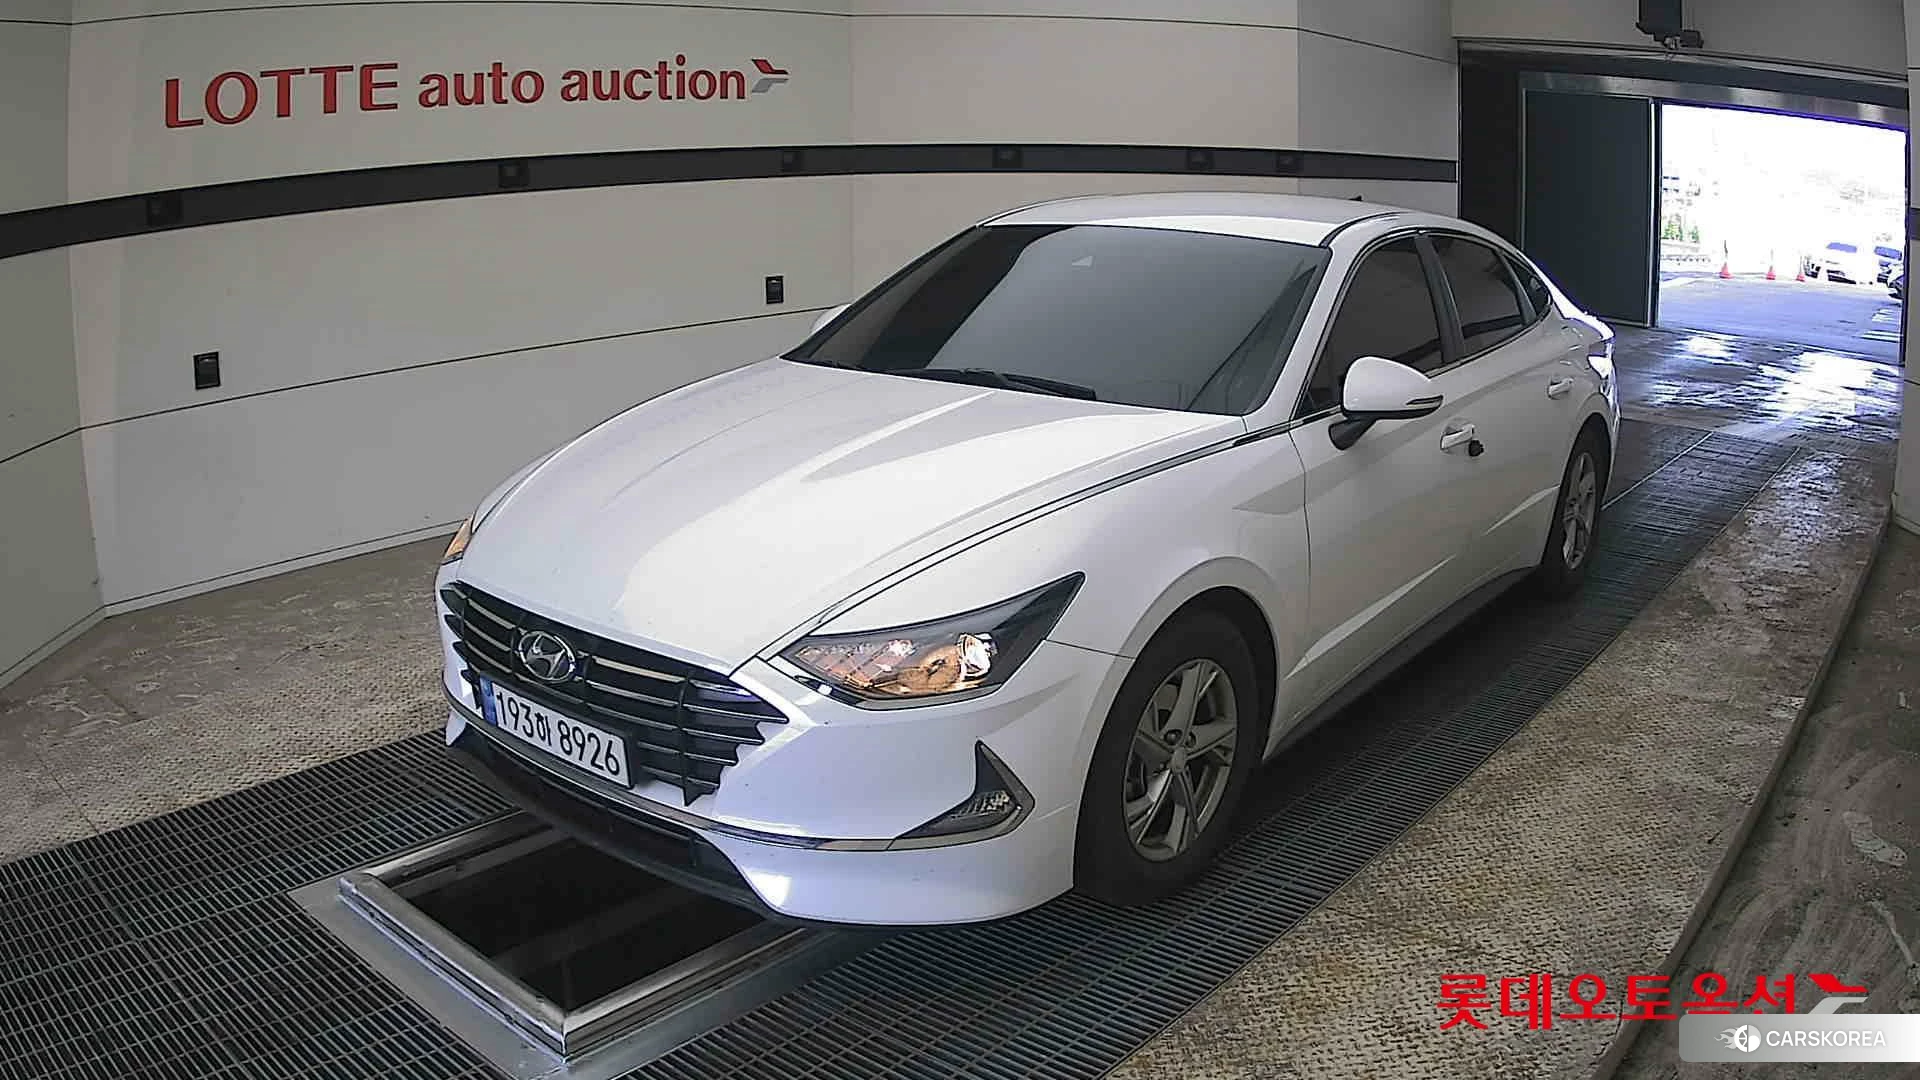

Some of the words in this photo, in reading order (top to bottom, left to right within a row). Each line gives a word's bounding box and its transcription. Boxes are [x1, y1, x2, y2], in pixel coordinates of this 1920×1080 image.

[164, 62, 400, 128] LOTTE
[418, 62, 545, 108] auto
[560, 55, 747, 101] auction
[557, 719, 621, 777] 8926
